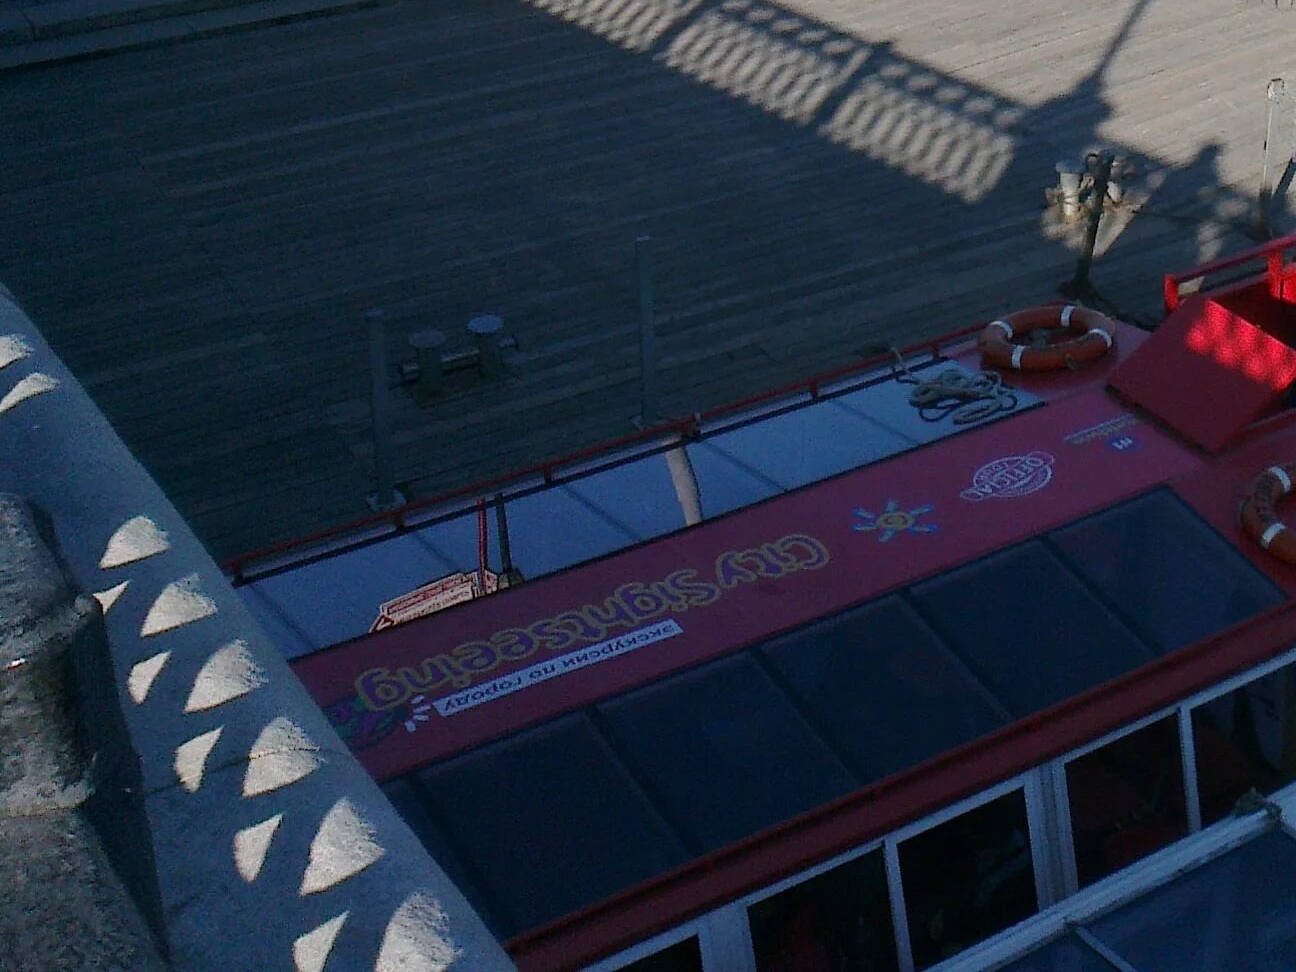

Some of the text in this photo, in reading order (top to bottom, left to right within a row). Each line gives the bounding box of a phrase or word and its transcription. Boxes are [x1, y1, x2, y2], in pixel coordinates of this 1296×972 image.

[714, 533, 829, 589] City
[355, 569, 721, 711] Sightseeing
[445, 623, 673, 711] экскурсии по городу
